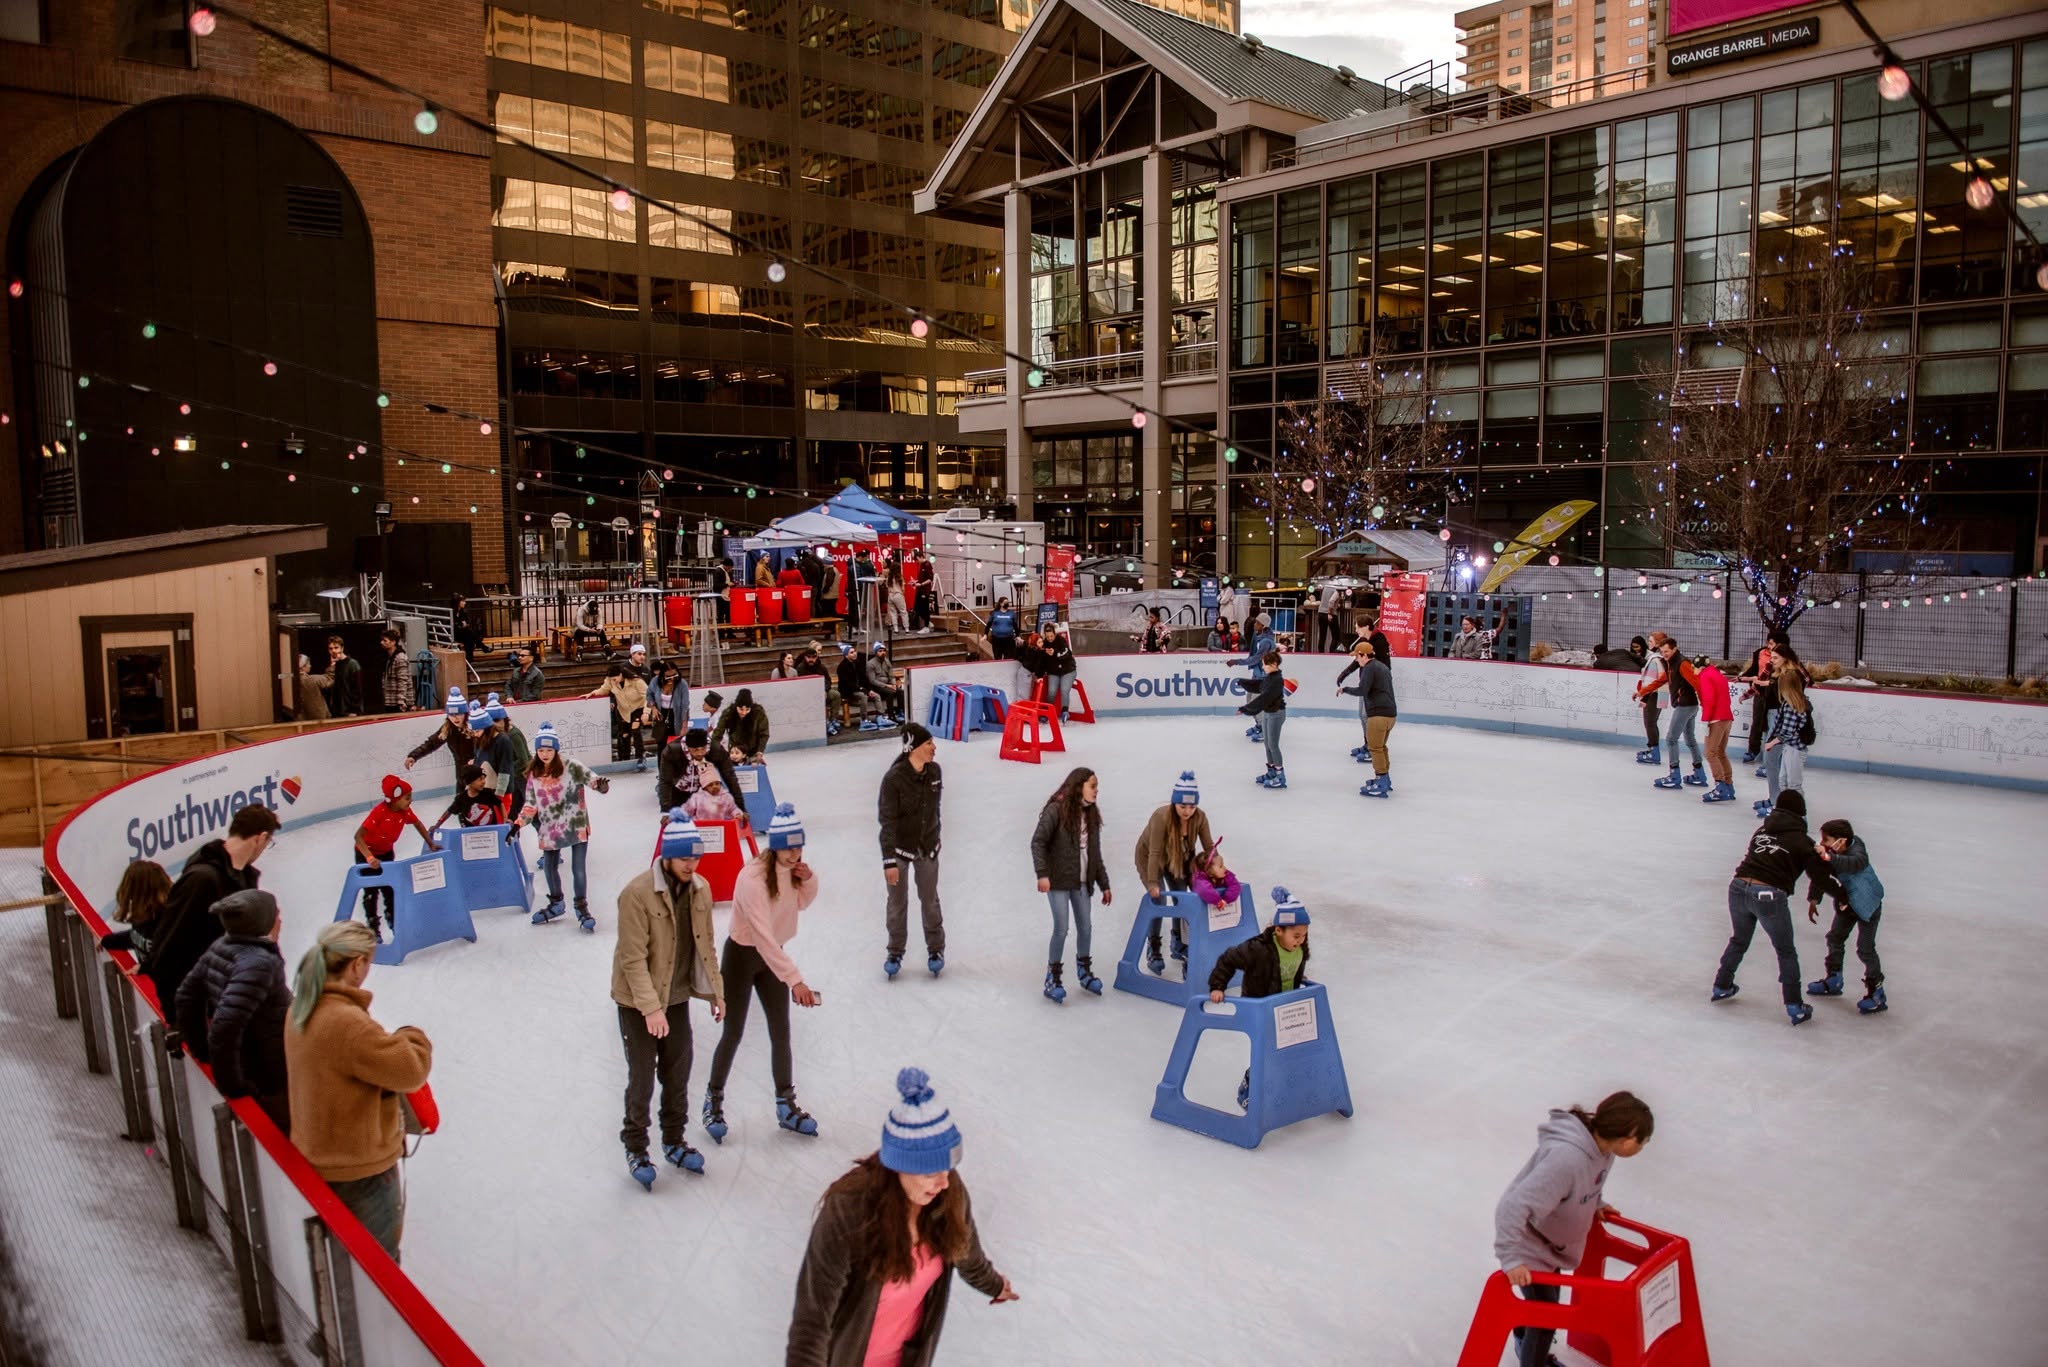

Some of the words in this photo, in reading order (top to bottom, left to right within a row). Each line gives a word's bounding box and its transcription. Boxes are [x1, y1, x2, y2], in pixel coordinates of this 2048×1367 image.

[1671, 46, 1720, 66] ORANGE
[1722, 36, 1767, 55] BARREL
[1771, 26, 1811, 44] MEDIA
[832, 553, 850, 562] ove
[1384, 601, 1400, 609] Now
[1040, 611, 1056, 619] STOP
[1382, 617, 1408, 628] nonstop
[1381, 624, 1405, 634] skating
[1115, 669, 1247, 699] Southwe
[188, 769, 217, 784] partnership
[217, 765, 229, 775] with
